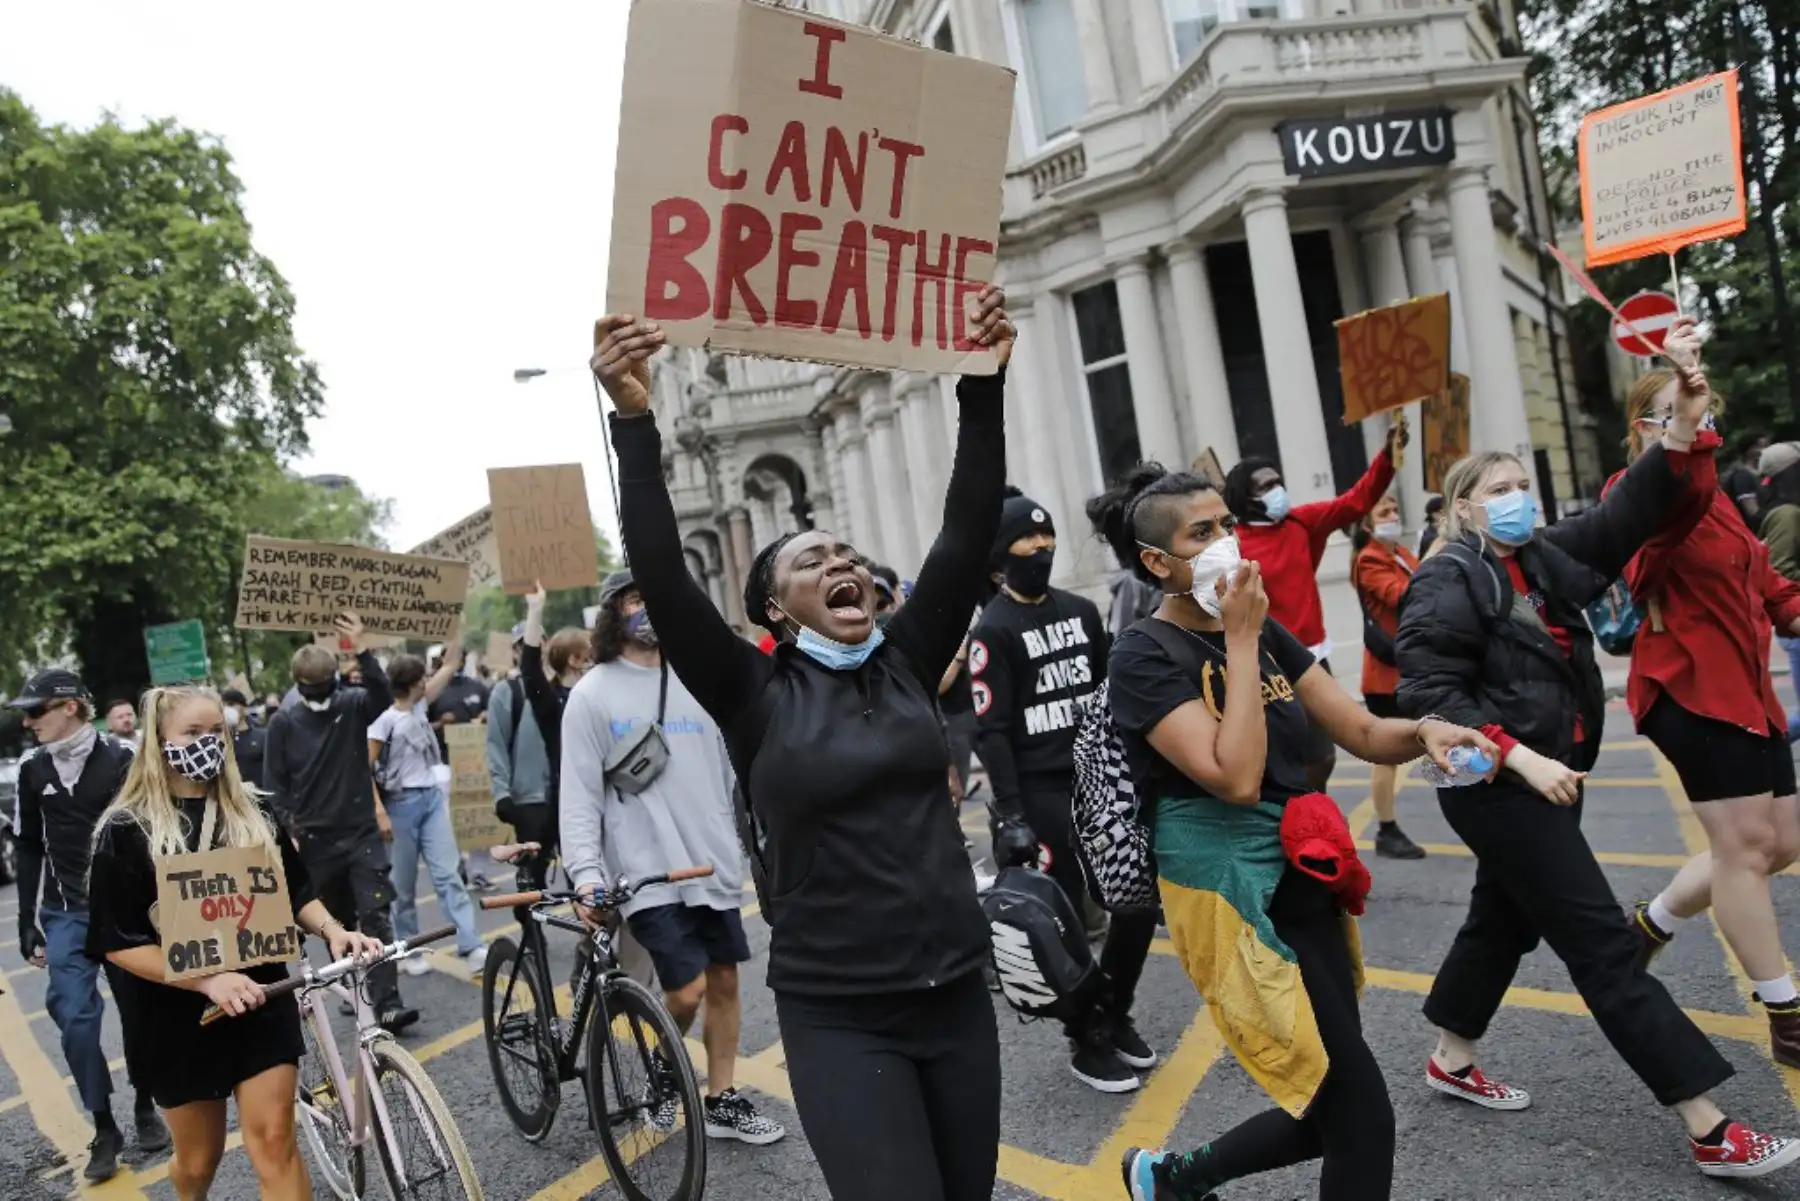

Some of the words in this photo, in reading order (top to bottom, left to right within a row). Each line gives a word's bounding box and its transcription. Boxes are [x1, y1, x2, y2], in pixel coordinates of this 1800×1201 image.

[798, 21, 846, 100] I
[1668, 100, 1685, 114] IS
[1293, 117, 1446, 167] KOUZU
[1596, 110, 1698, 154] INNOCENT
[707, 114, 925, 219] CAN'T
[1595, 219, 1643, 241] LIVES
[1649, 196, 1733, 228] GLOBALLY
[644, 196, 994, 352] BREATHE
[502, 501, 581, 537] THEIR
[250, 548, 338, 569] REMEMBER
[340, 556, 380, 574] MARK
[381, 562, 442, 584] DUGGAN,
[508, 540, 587, 578] NAMES
[245, 570, 301, 588] SARAH
[310, 573, 355, 593] REED,
[359, 578, 426, 598] CYNTHIA
[335, 594, 400, 613] STEPHEN
[276, 612, 300, 624] UK
[303, 613, 318, 625] IS
[1021, 617, 1089, 660] BLACK
[1035, 654, 1092, 695] LIVES
[247, 866, 279, 893] IS
[200, 894, 256, 931] ONLY
[168, 938, 222, 973] ONE
[236, 925, 296, 962] RACE!
